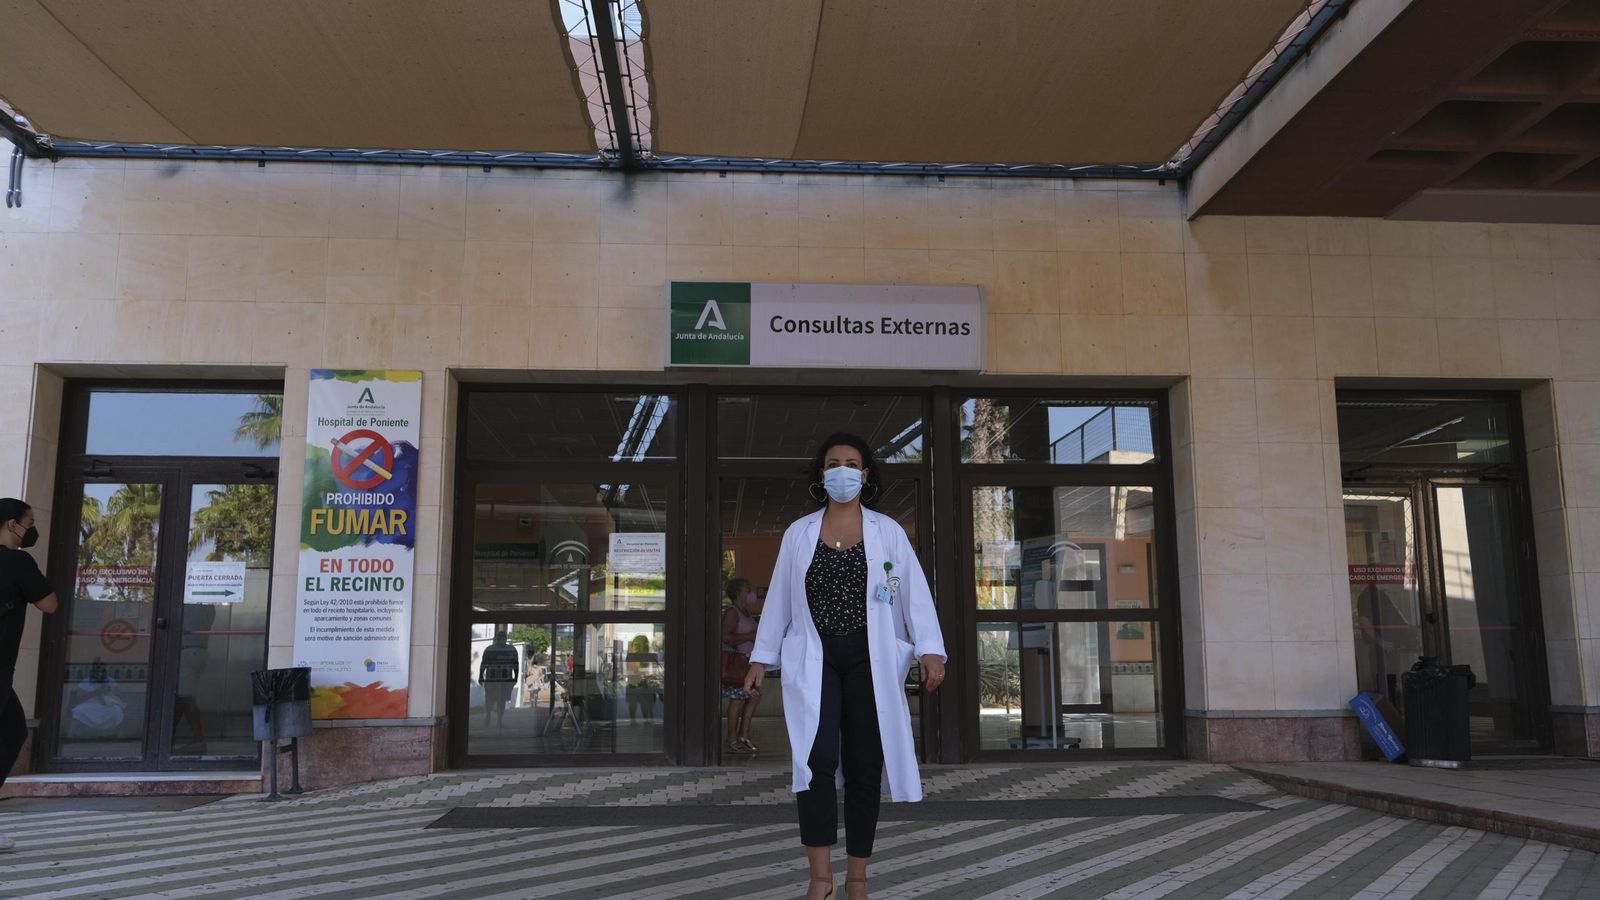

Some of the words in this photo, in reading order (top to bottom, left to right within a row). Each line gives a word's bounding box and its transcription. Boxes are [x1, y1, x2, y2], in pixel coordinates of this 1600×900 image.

[770, 315, 874, 334] Consultas
[881, 317, 970, 336] Externas
[675, 332, 696, 341] Junta
[698, 332, 707, 340] de
[708, 332, 744, 341] Andalucía
[318, 417, 354, 428] Hospital
[356, 417, 367, 427] de
[370, 418, 409, 427] Poniente
[326, 493, 394, 505] PROHIBIDO
[310, 509, 408, 535] FUMAR
[320, 558, 342, 573] EN
[348, 558, 394, 573] TODO
[305, 577, 325, 592] EL
[330, 577, 405, 592] RECINTO
